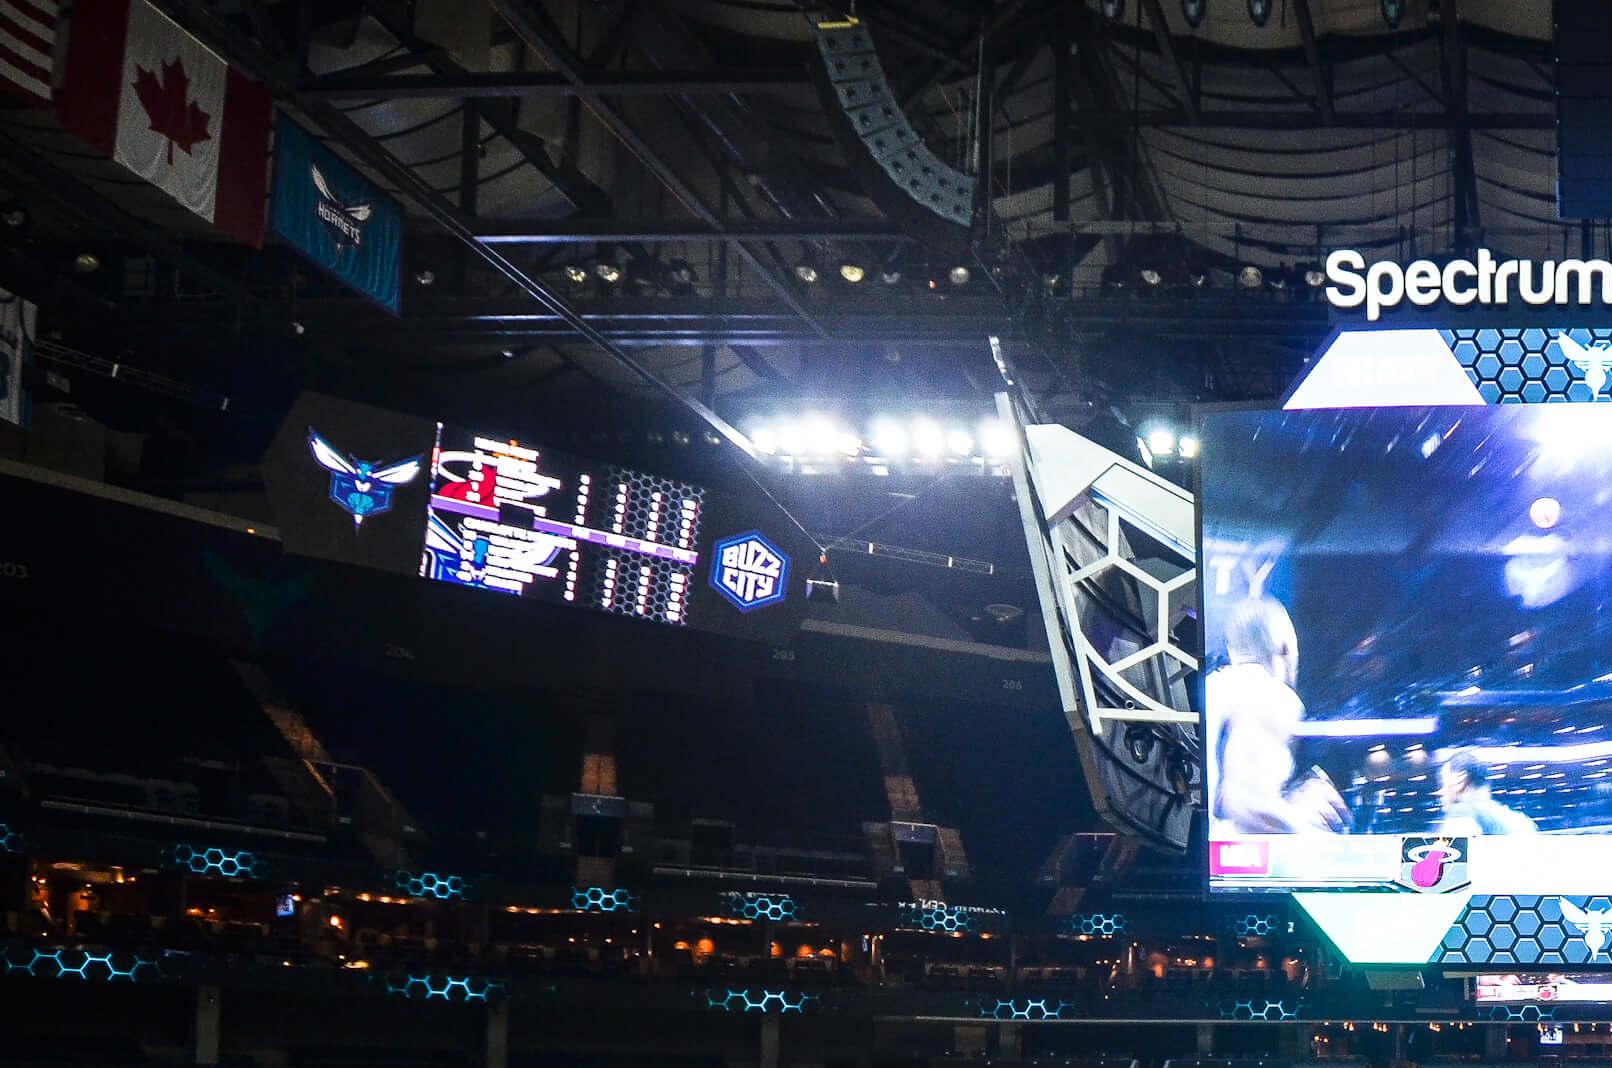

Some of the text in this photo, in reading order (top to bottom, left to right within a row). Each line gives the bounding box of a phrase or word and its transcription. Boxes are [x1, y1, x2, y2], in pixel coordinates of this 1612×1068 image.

[318, 201, 361, 245] HORNETS
[0, 562, 29, 579] 03
[722, 540, 781, 578] BUZZ
[722, 565, 775, 602] CITY
[772, 649, 796, 661] 205
[1001, 678, 1023, 691] 206
